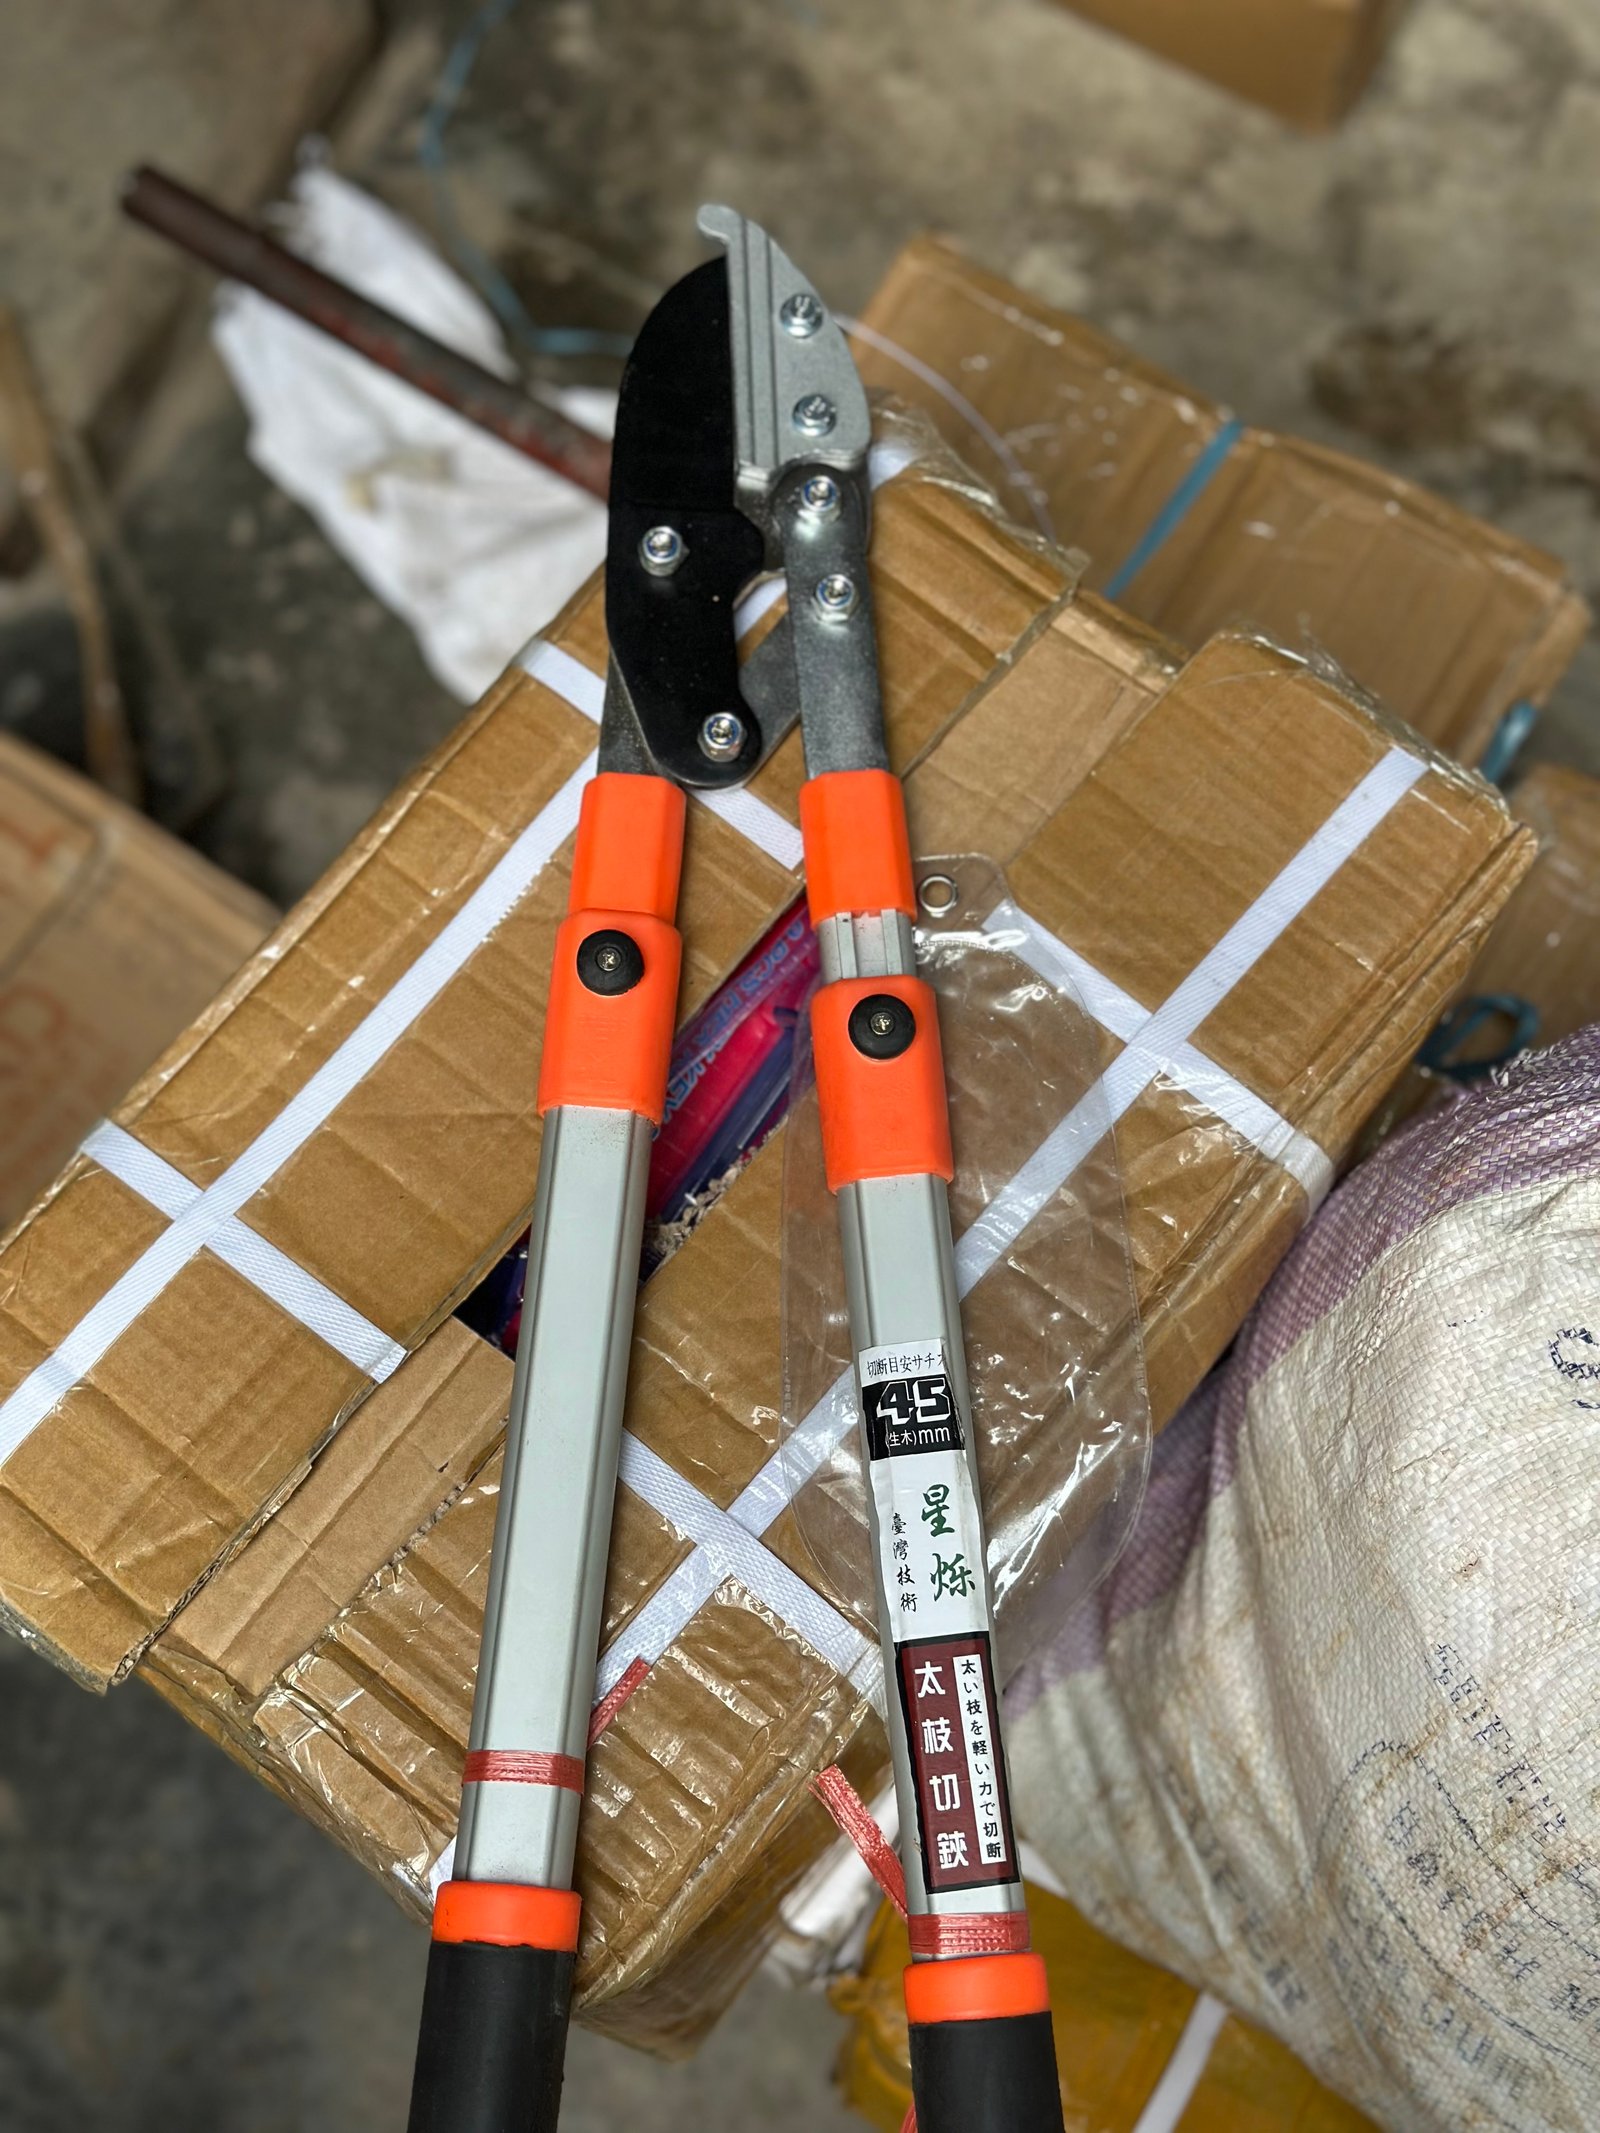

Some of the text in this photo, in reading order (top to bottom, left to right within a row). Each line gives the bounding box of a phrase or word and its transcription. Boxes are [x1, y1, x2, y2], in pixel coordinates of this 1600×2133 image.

[876, 1377, 951, 1426] 45
[961, 1659, 1002, 1859] 太い枝を軽い力で切断
